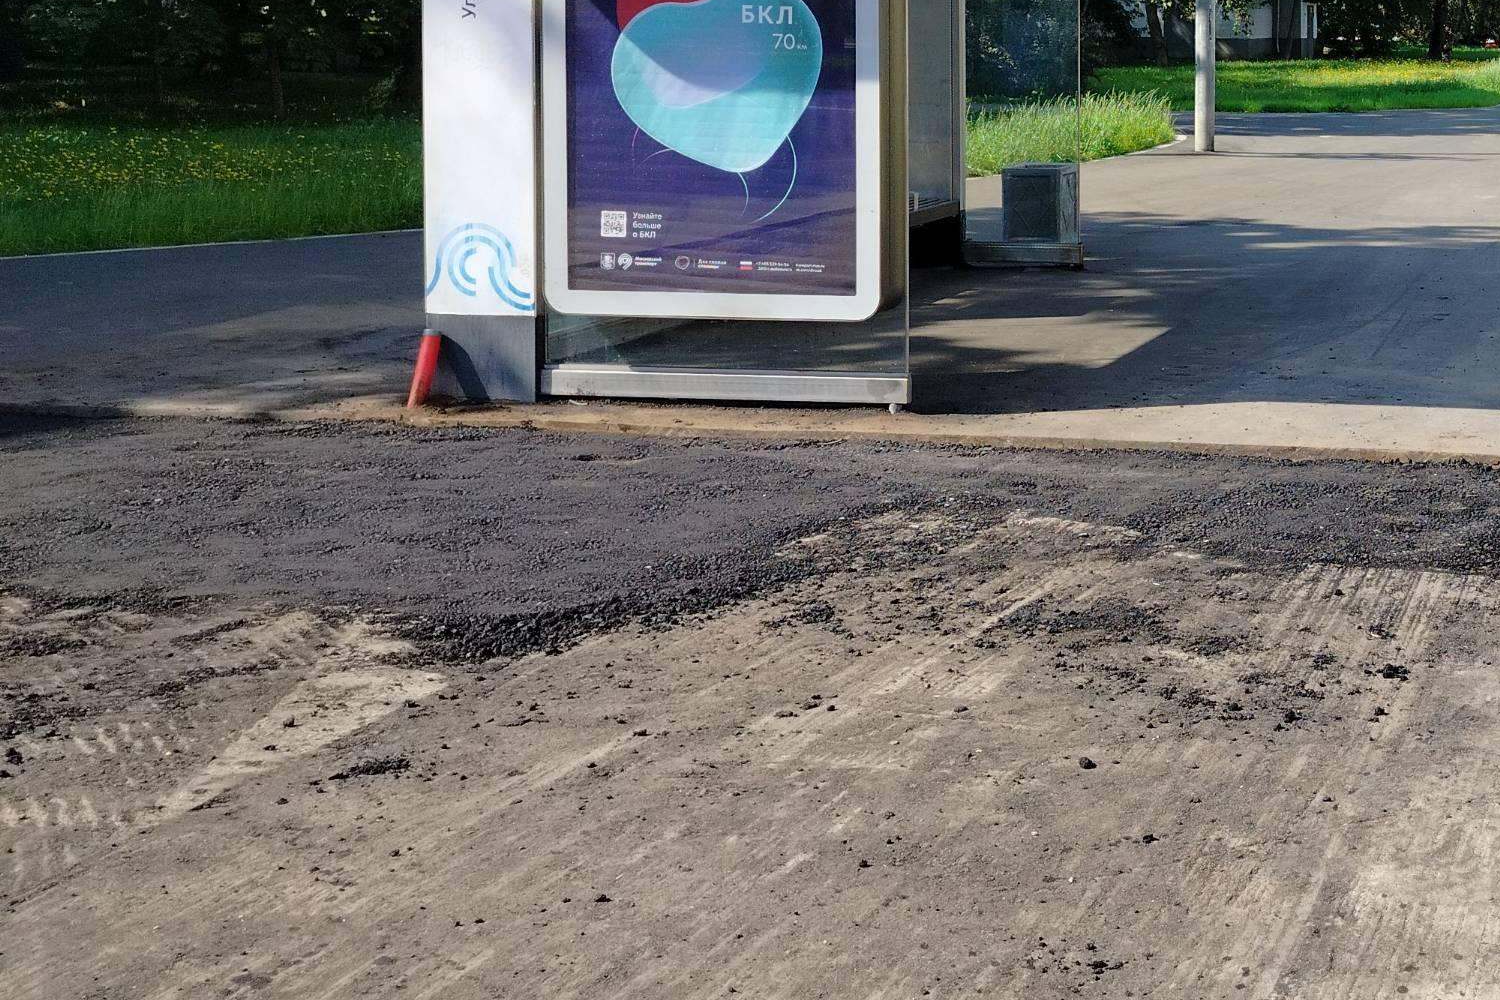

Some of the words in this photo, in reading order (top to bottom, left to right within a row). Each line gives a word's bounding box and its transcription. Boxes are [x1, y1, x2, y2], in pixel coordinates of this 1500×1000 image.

[741, 4, 794, 25] БКЛ
[772, 33, 796, 50] 70
[632, 211, 663, 220] Узнайте
[632, 220, 662, 230] больше
[639, 230, 656, 239] БКЛ
